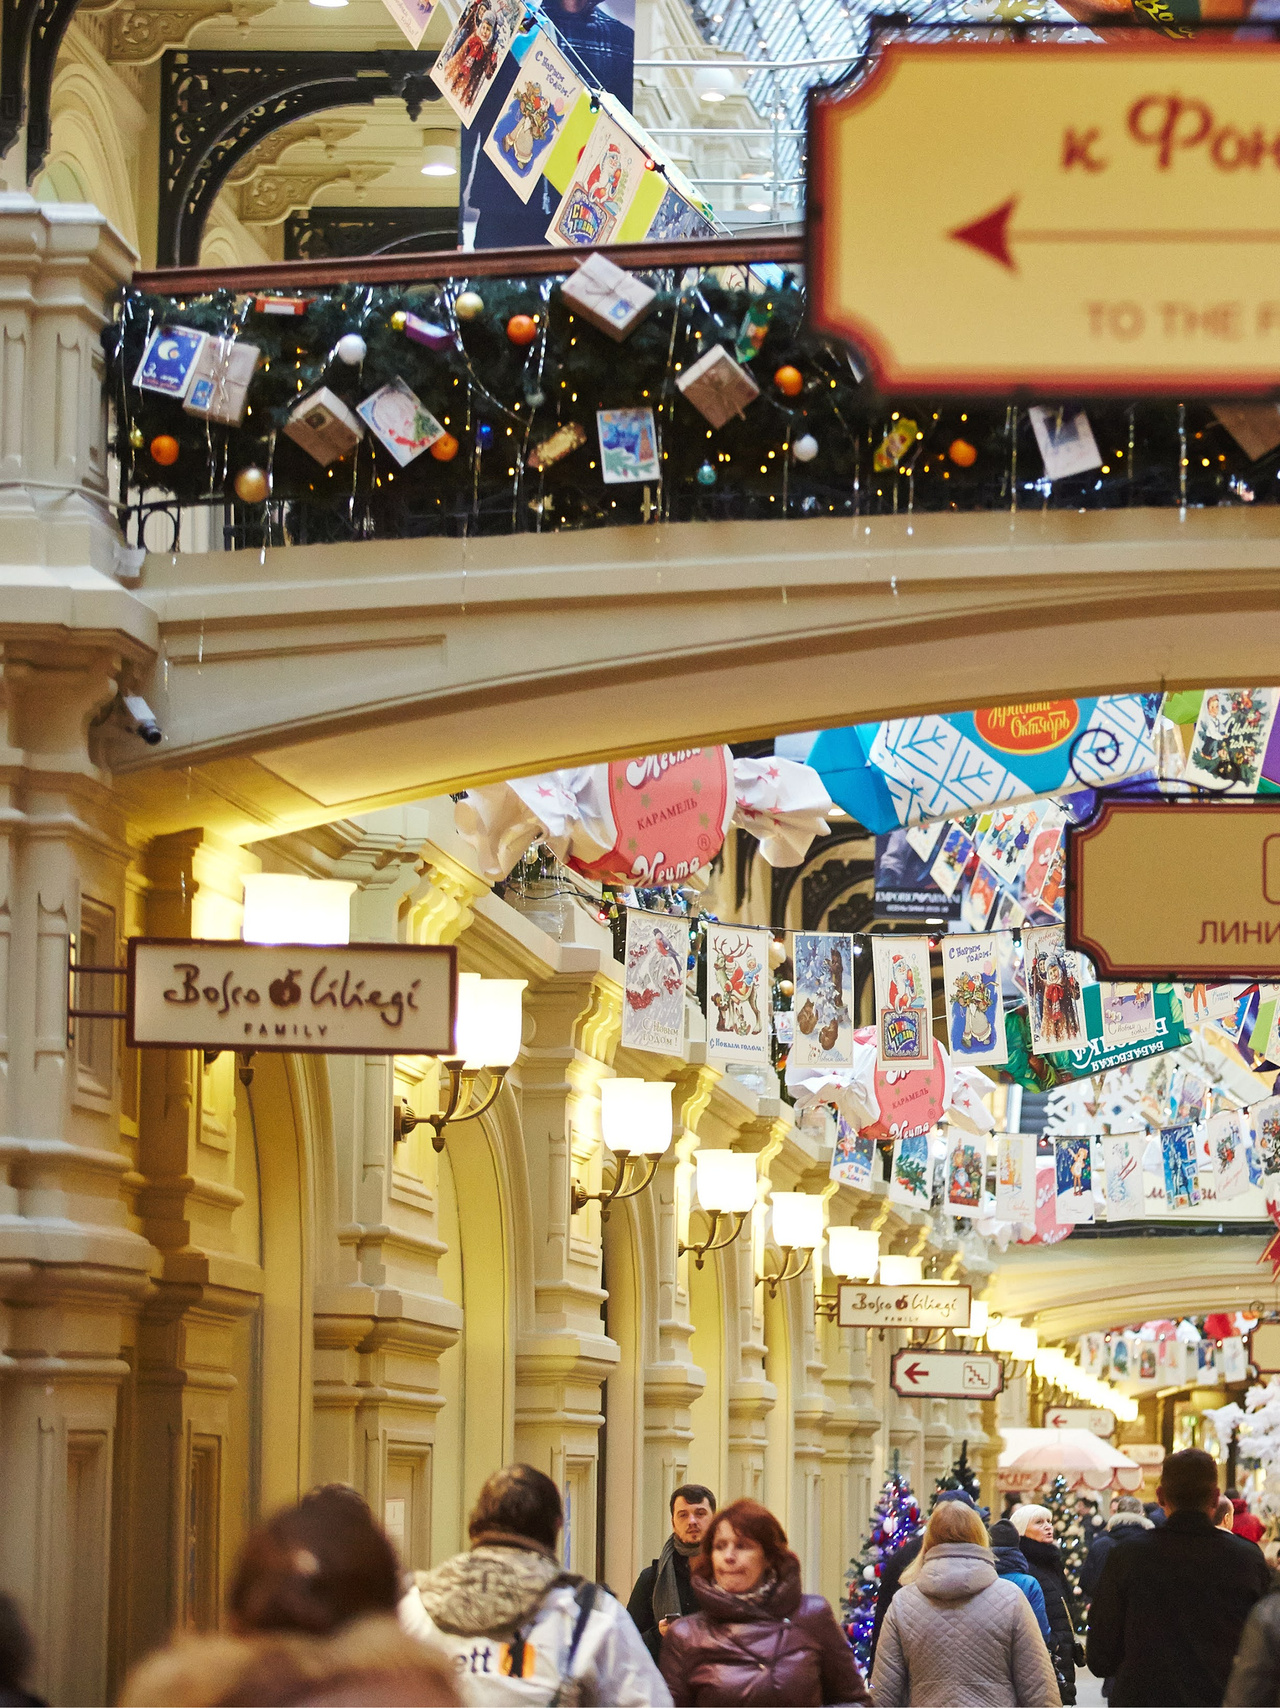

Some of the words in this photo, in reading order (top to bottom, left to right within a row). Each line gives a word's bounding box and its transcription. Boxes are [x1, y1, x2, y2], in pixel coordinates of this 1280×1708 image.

[1084, 303, 1145, 341] TO
[1159, 303, 1242, 341] THE
[1010, 710, 1070, 741] Октябрь
[637, 797, 698, 831] КАРАМЕЛЬ
[163, 962, 261, 1014] Bosco
[310, 965, 421, 1026] Ciliegi
[244, 1022, 329, 1037] FAMILY
[1092, 1041, 1164, 1072] БАБАЕВСКАЯ
[892, 1087, 929, 1110] КАРАМЕЛЬ
[852, 1292, 892, 1314] Bosco
[912, 1293, 957, 1317] Ciliegi
